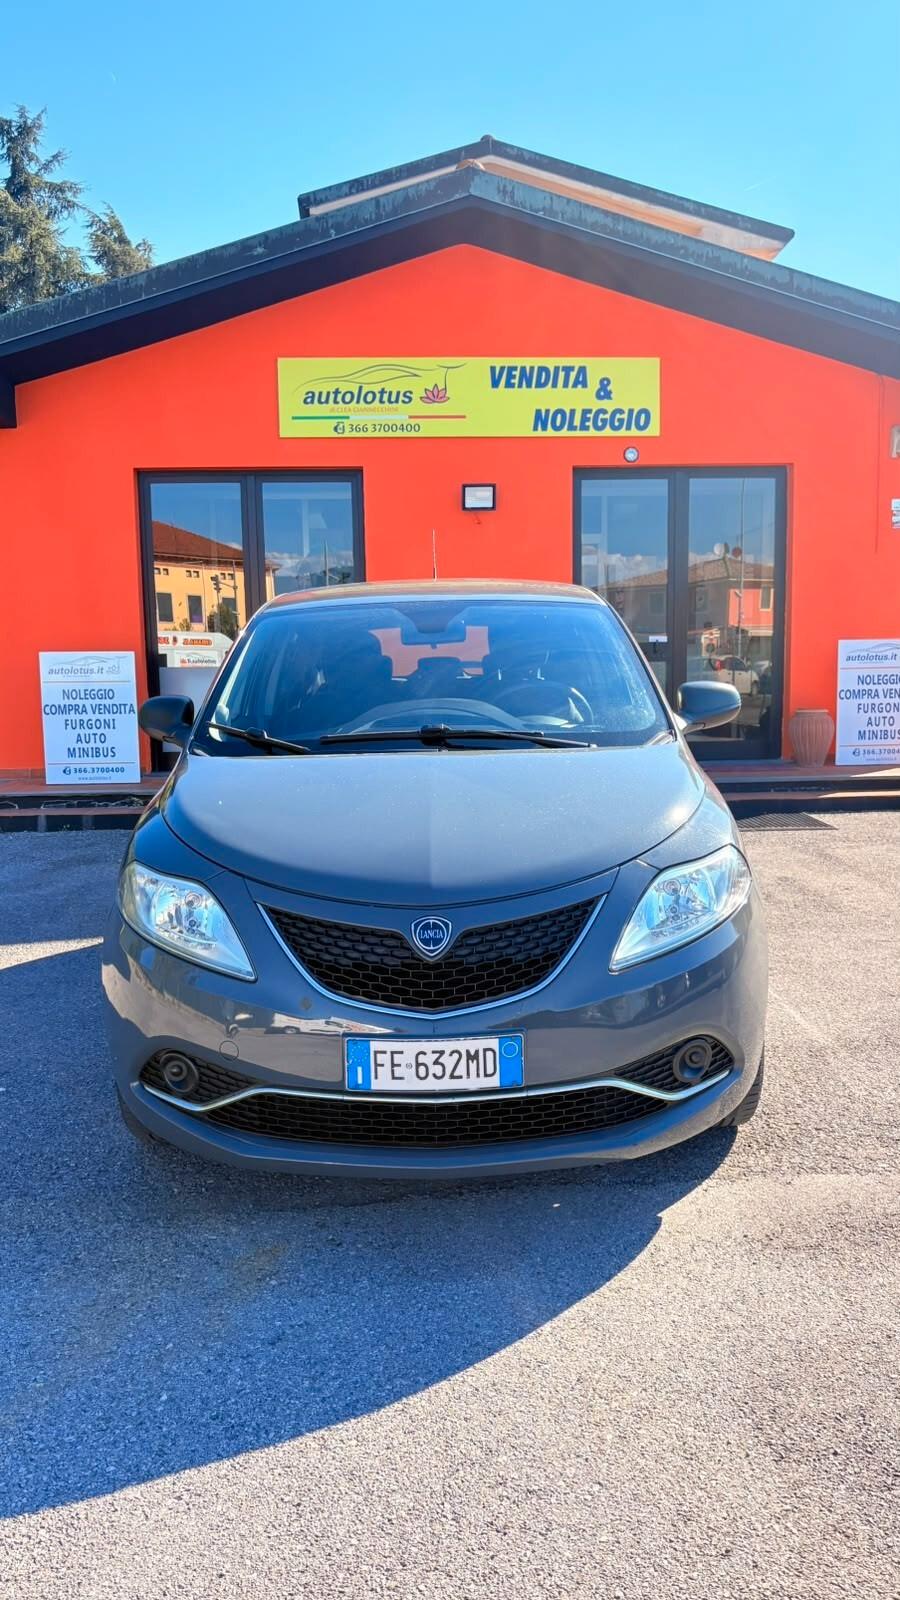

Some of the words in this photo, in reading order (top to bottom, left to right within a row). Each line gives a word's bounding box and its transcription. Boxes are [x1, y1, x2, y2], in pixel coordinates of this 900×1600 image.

[489, 365, 588, 389] VENDITA
[595, 377, 613, 400] &
[303, 385, 414, 405] autolotus
[532, 408, 651, 432] NOLEGGIO
[348, 423, 369, 433] 366
[371, 422, 421, 433] 3700400
[846, 653, 897, 661] autolotus.it
[48, 667, 104, 675] autolotus.it
[62, 688, 115, 701] NOLEGGIO
[839, 689, 880, 700] COMPRA
[43, 704, 87, 716] COMPRA
[91, 703, 135, 715] VENDITA
[64, 719, 116, 730] FURGONI
[866, 716, 895, 727] AUTO
[76, 733, 107, 744] AUTO
[67, 747, 116, 759] MINIBUS
[73, 766, 125, 774] 366.3700400
[420, 929, 444, 939] LANCIA
